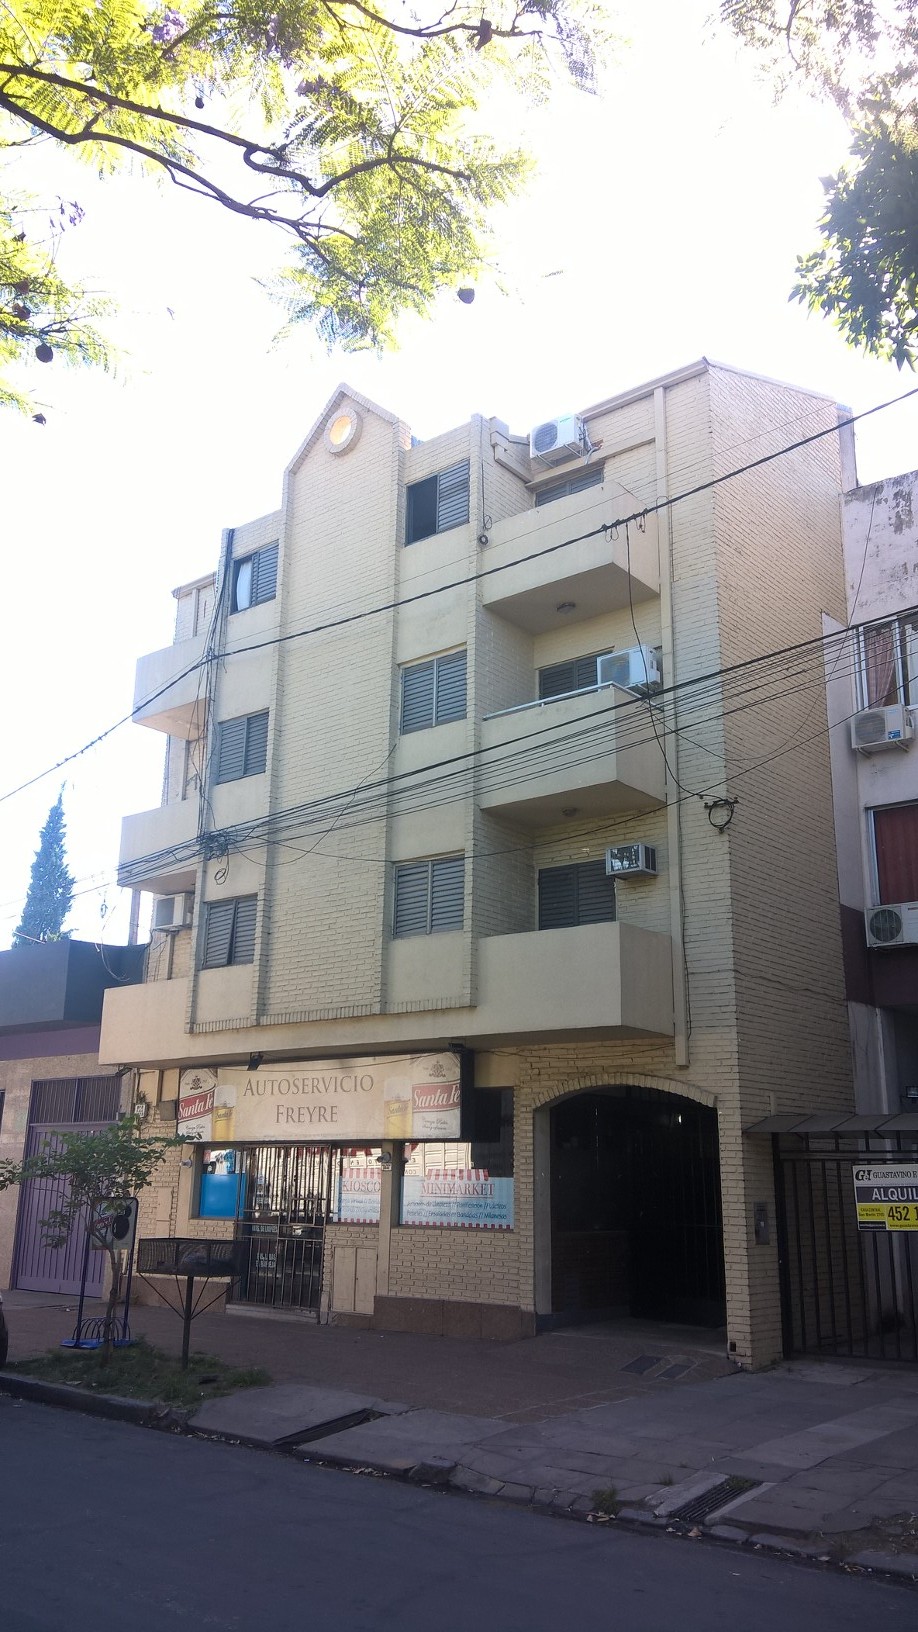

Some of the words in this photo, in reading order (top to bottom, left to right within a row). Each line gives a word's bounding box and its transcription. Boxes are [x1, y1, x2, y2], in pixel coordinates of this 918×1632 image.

[243, 1075, 374, 1096] AUTOSERVICIO
[414, 1089, 447, 1108] Santa
[178, 1101, 204, 1119] Santa
[276, 1104, 338, 1123] FREYRE
[873, 1171, 912, 1179] GUASTAVINO
[342, 1181, 381, 1192] KIOSCO
[421, 1183, 495, 1196] MINIMARKET
[888, 1206, 910, 1221] 452
